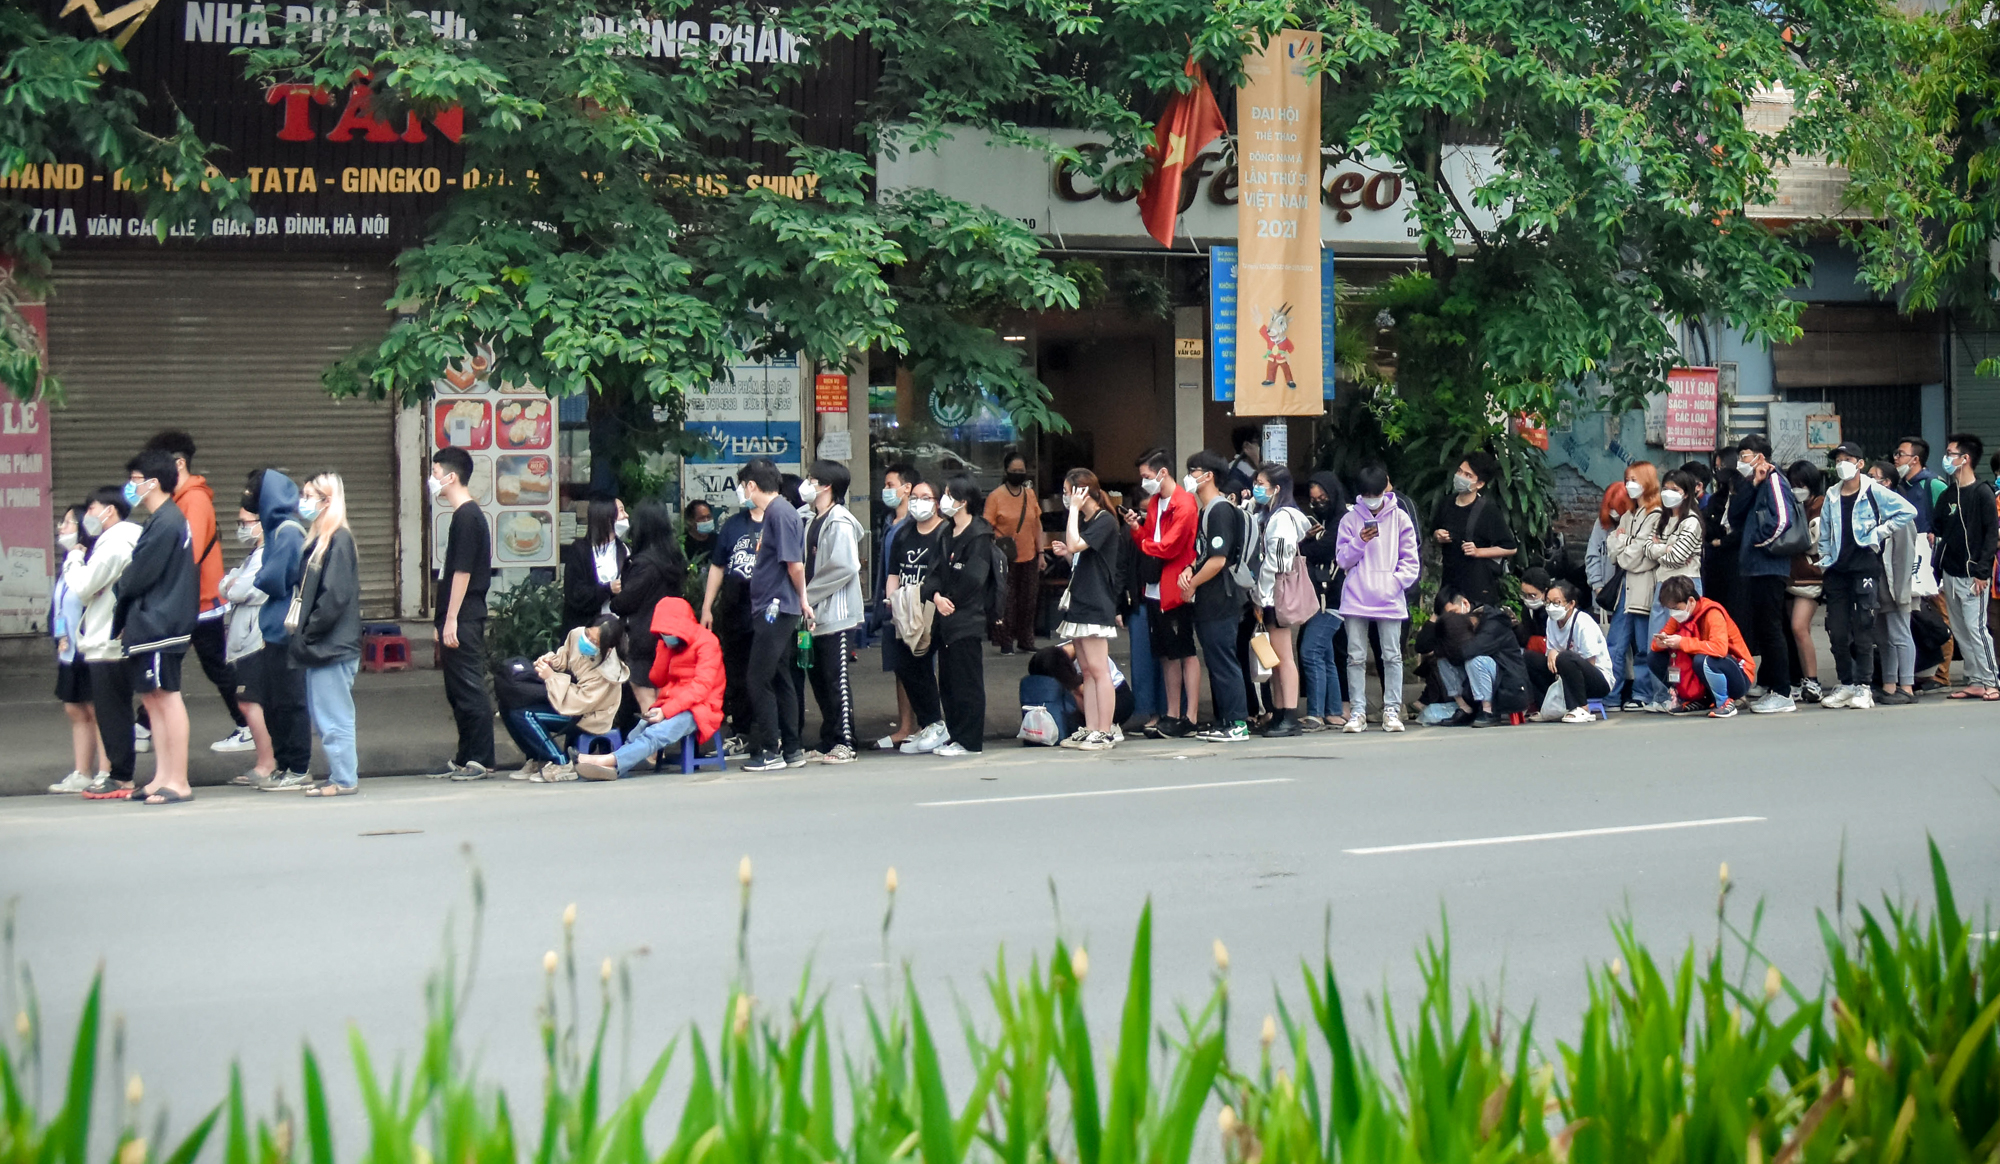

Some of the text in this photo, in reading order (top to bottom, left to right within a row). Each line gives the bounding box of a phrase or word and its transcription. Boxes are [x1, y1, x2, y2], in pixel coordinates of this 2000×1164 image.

[1251, 105, 1299, 125] ĐẠI HỘI
[1274, 131, 1297, 142] THAO
[1276, 153, 1295, 163] NAM
[248, 167, 317, 194] TATA
[342, 167, 441, 193] GINGKO
[747, 174, 819, 200] SHINY
[1244, 165, 1308, 186] LẦN THỨ 31
[1244, 188, 1309, 213] VIỆT NAM
[29, 208, 77, 236] 71A
[87, 214, 122, 236] VĂN
[255, 216, 279, 235] BA
[284, 213, 330, 236] ĐÌNH,
[333, 213, 356, 235] HÀ
[361, 213, 389, 239] NỘI
[1257, 219, 1298, 239] 2021
[1686, 378, 1696, 395] LÝ
[1698, 381, 1716, 399] GẠO
[1668, 399, 1688, 411] SẠCH
[1694, 400, 1714, 410] NGON
[1675, 410, 1689, 422] CÁC
[1691, 413, 1708, 425] LOẠI
[732, 436, 788, 455] HAND
